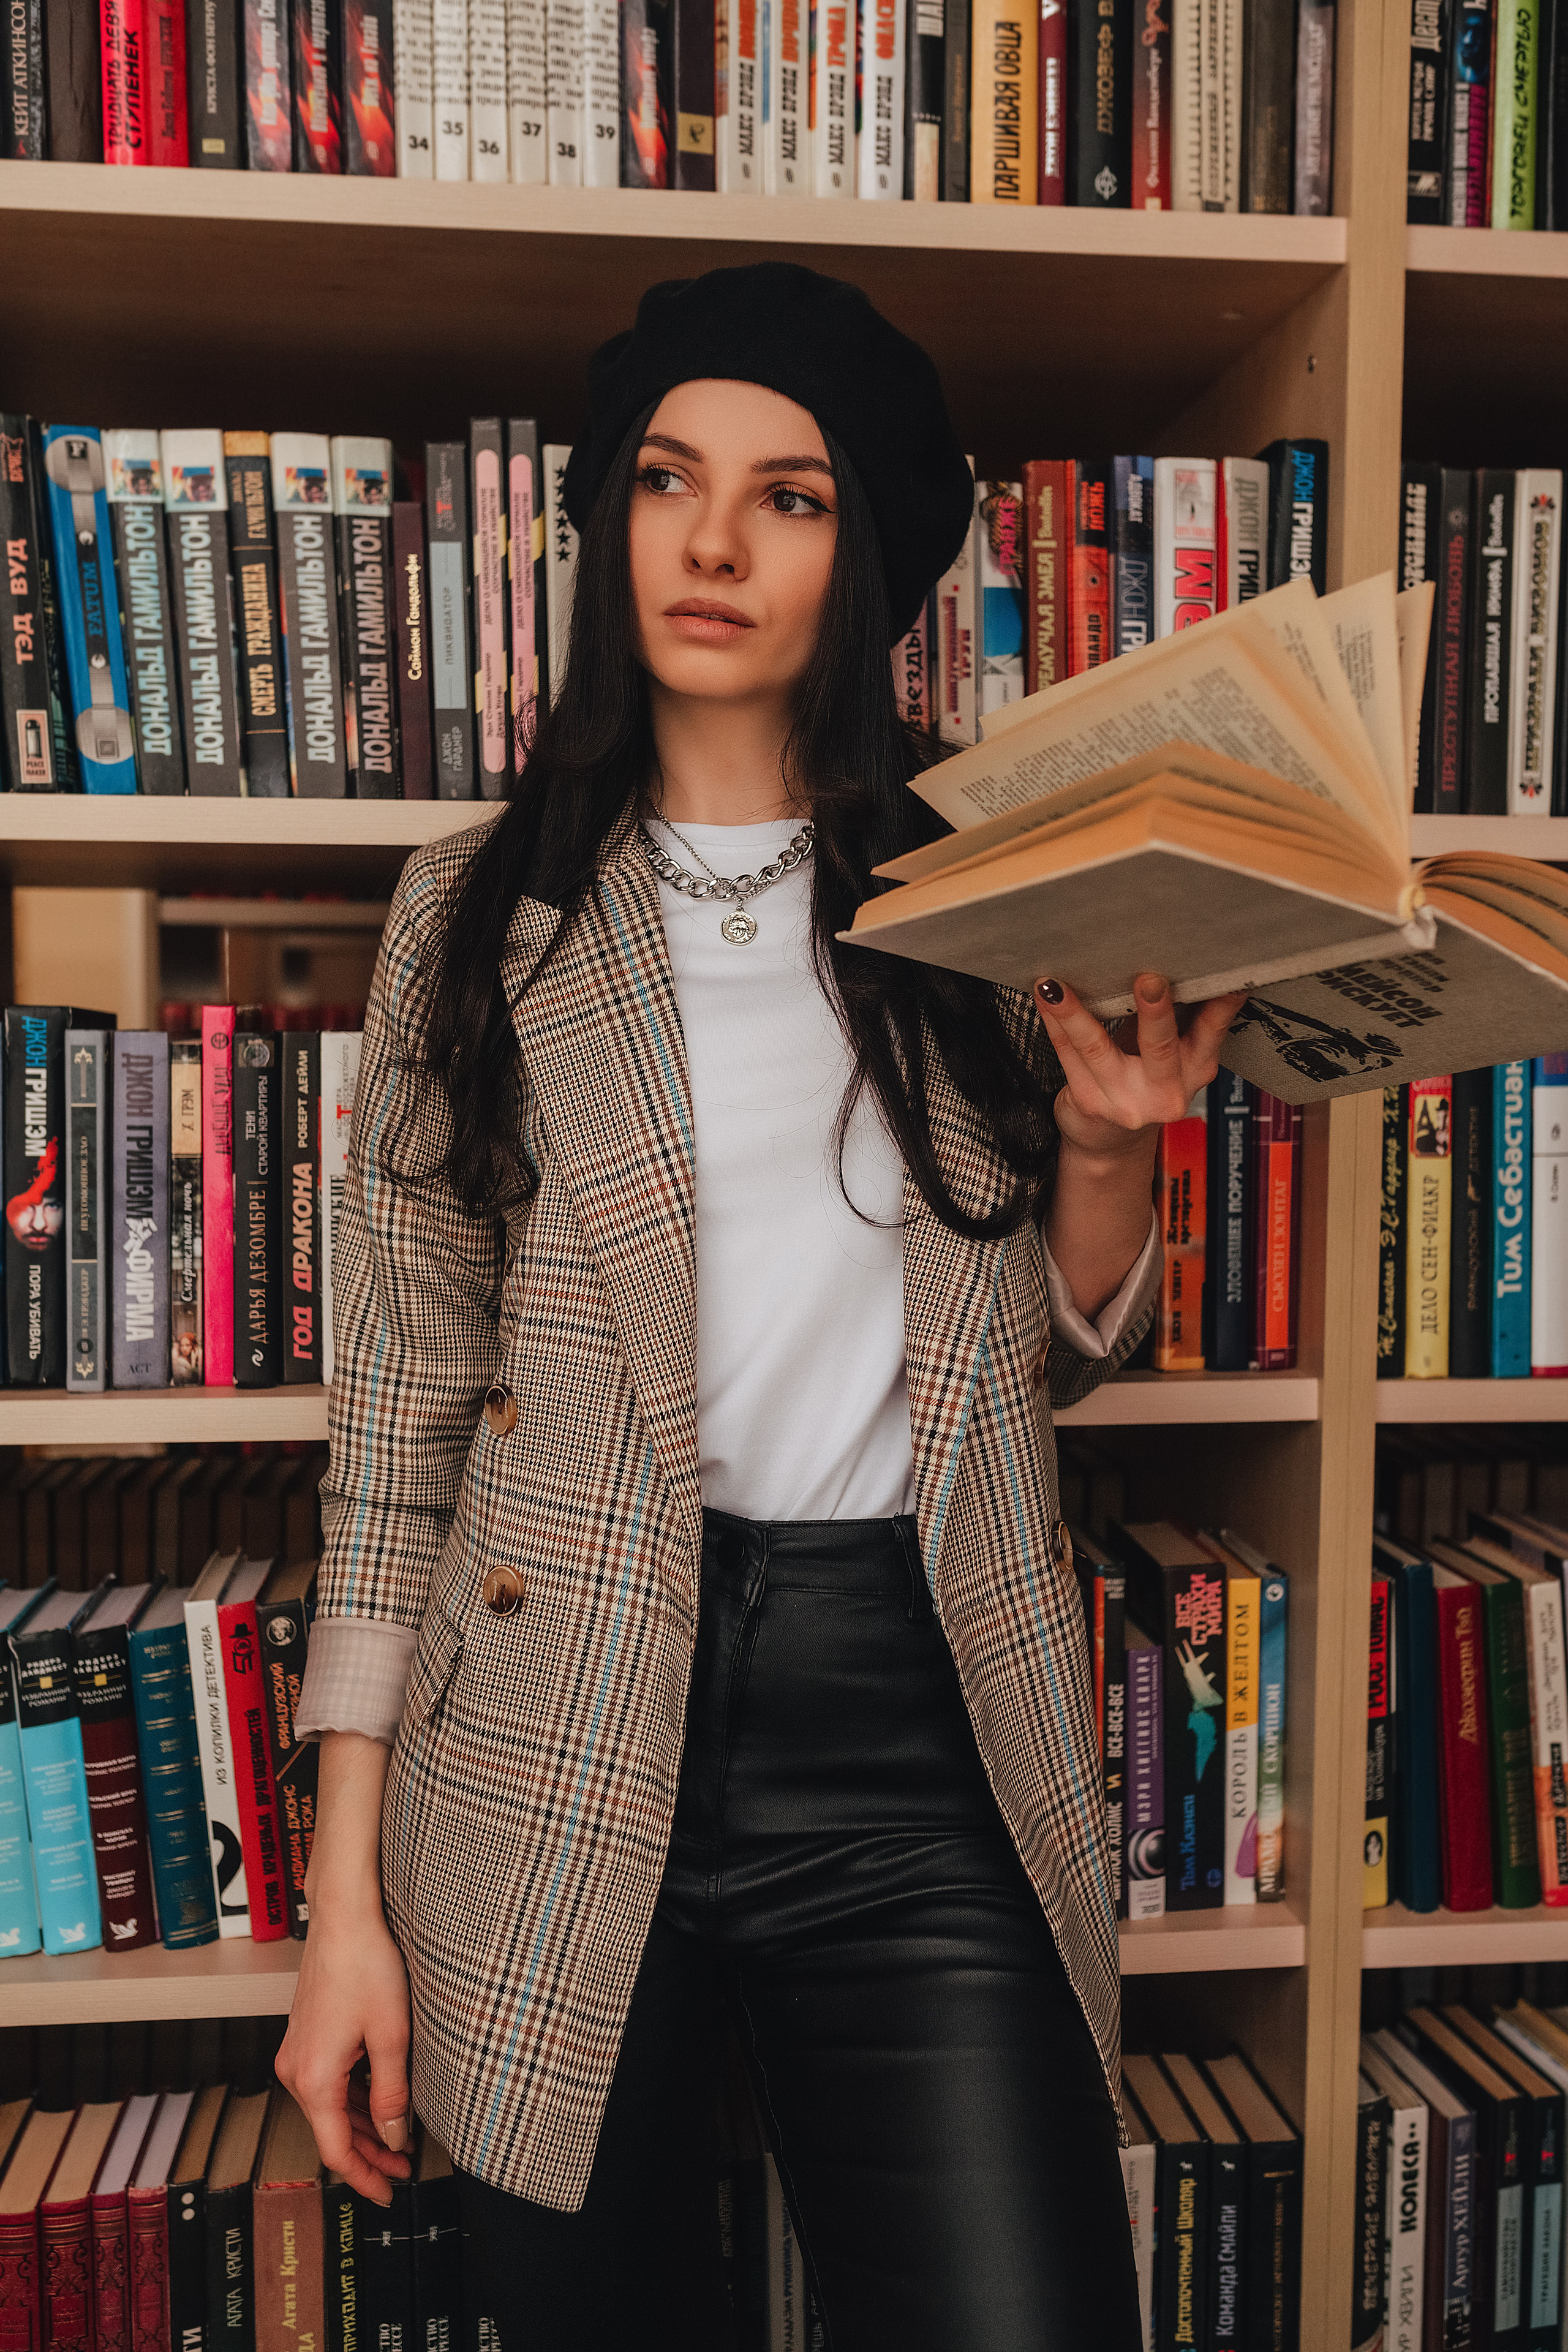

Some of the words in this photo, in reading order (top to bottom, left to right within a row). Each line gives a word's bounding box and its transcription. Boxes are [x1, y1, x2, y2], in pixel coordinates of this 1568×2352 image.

[205, 37, 216, 67] ФОН
[827, 7, 846, 67] ТРОПА
[994, 19, 1022, 75] ОВЦА
[1513, 9, 1531, 108] СМЕРТЬЮ
[107, 59, 123, 148] ТРИДЦАТЬ
[124, 28, 141, 148] СТУПЕНЕК
[205, 67, 217, 114] КРИСТА
[739, 62, 754, 108] БРЭНД
[782, 67, 797, 113] БРЭНД
[828, 72, 845, 118] БРЭНД
[876, 75, 892, 121] БРЭНД
[1096, 22, 1114, 134] ДЖОЗЕФ
[12, 89, 29, 135] КЕЙТ
[442, 121, 464, 136] 35
[521, 121, 541, 137] 37
[595, 124, 616, 138] 39
[739, 114, 753, 156] МАКС
[782, 118, 796, 160] МАКС
[993, 80, 1022, 200] ПАРШИВАЯ
[408, 135, 428, 151] 34
[478, 140, 500, 155] 36
[557, 142, 576, 158] 38
[827, 123, 844, 165] МАКС
[875, 126, 891, 167] МАКС
[1510, 113, 1529, 219] ТОРГОВЕЦ
[244, 470, 268, 538] ГАМИЛЬТОН
[1291, 450, 1315, 502] ДЖОН
[998, 496, 1017, 575] ГРАНЖЕ
[1235, 478, 1260, 543] ДЖОН
[7, 538, 30, 596] ВУД
[123, 505, 162, 640] ГАМИЛЬТОН
[179, 514, 218, 650] ГАМИЛЬТОН
[293, 515, 330, 649] ГАМИЛЬТОН
[352, 519, 388, 655] ГАМИЛЬТОН
[405, 554, 421, 625] Гандольфи
[1037, 552, 1055, 600] ЗМЕЯ
[1120, 557, 1148, 618] ДЖОН
[1446, 535, 1464, 636] ЛЮБОВЬ
[1486, 559, 1503, 616] НИМФА
[82, 560, 104, 637] FATUM
[241, 563, 274, 655] ГРАЖДАНИНА
[443, 587, 454, 666] ЛИКВИДАТОР
[13, 613, 34, 665] ТЭД
[407, 627, 422, 680] Саймон
[1038, 605, 1055, 688] РЕМУЧАЯ
[248, 663, 277, 715] СМЕРТЬ
[1483, 622, 1501, 723] ПРОПАВШАЯ
[134, 647, 172, 756] ДОНАЛЬД
[187, 655, 224, 766] ДОНАЛЬД
[303, 655, 336, 763] ДОНАЛЬД
[360, 662, 393, 774] ДОНАЛЬД
[1441, 642, 1460, 792] ПРЕСТУПНАЯ
[442, 733, 452, 765] ДЖОН
[451, 726, 462, 772] ГАРДНЕР
[21, 1016, 47, 1068] ДЖОН
[123, 1053, 154, 1117] ДЖОН
[295, 1050, 309, 1094] ДЕЙЛИ
[24, 1068, 47, 1157] ГРИШЭМ
[181, 1088, 194, 1116] ГРЭМ
[245, 1110, 256, 1140] ТЕНИ
[257, 1075, 268, 1131] КВАРТИРЫ
[296, 1098, 309, 1148] РОБЕРТ
[80, 1136, 90, 1156] ЗЛО
[126, 1125, 154, 1219] ГРИШЭМ
[255, 1133, 268, 1175] СТАРОЙ
[1227, 1119, 1243, 1213] ПОРУЧЕНИЕ
[183, 1182, 193, 1212] ночь
[249, 1191, 270, 1283] ДЕЗОМБРЕ
[292, 1163, 314, 1292] ДРАКОНА
[1421, 1175, 1439, 1282] СЕН-ФИАКР
[28, 1265, 42, 1299] ПОРА
[181, 1215, 197, 1302] Смертельная
[1227, 1218, 1243, 1303] ЗЛОВЕЩЕЕ
[1496, 1232, 1523, 1298] Тим
[126, 1250, 155, 1342] ФИРМА
[249, 1288, 270, 1344] ДАРЬЯ
[1420, 1288, 1439, 1335] ДЕЛО
[28, 1302, 42, 1360] УБИВАТЬ
[293, 1306, 313, 1360] ГОД
[1175, 1593, 1191, 1629] ВСЕ
[1191, 1573, 1207, 1646] СТРАХИ
[1205, 1580, 1223, 1635] МИРА
[200, 1625, 221, 1700] ДЕТЕКТИВА
[1136, 1655, 1152, 1703] КЛАРК
[1232, 1604, 1250, 1702] ЖЕЛТОМ
[28, 1695, 67, 1708] РОМАНЫ
[83, 1692, 123, 1705] РОМАНЫ
[270, 1662, 292, 1750] ФРАНЦУЗСКИЙ
[1107, 1683, 1124, 1758] ВСЕ-ВСЕ-ВСЕ
[1232, 1710, 1248, 1722] В
[209, 1703, 225, 1765] КОПИЛКИ
[244, 1707, 273, 1806] ДРАГОЦЕННОСТЕЙ
[1136, 1709, 1151, 1774] ХИГГИНС
[1261, 1683, 1281, 1773] СКОРПИОН
[216, 1768, 228, 1786] ИЗ
[1135, 1782, 1152, 1822] МЭРИ
[1232, 1733, 1248, 1819] КОРОЛЬ
[283, 1784, 301, 1830] ДЖОНС
[301, 1795, 315, 1829] РОКА
[1106, 1801, 1122, 1845] ХОЛМС
[255, 1813, 276, 1875] КРАДЕНЫХ
[288, 1833, 306, 1891] ИНДИАНА
[263, 1881, 282, 1926] ОСТРОВ
[1176, 2177, 1198, 2230] Школяр
[1400, 2140, 1419, 2234] КОЛЕСА
[1450, 2154, 1469, 2231] ХЕЙЛИ
[225, 2227, 244, 2279] КРИСТИ
[280, 2220, 298, 2277] Кристи
[339, 2202, 356, 2253] КОНЦЕ
[1217, 2205, 1238, 2263] Смайли
[340, 2257, 355, 2268] В
[1174, 2234, 1195, 2343] Достопочтенный
[1452, 2234, 1471, 2288] Артур
[226, 2287, 243, 2328] АГАТА
[282, 2284, 296, 2329] Агата
[1215, 2266, 1238, 2337] Команда
